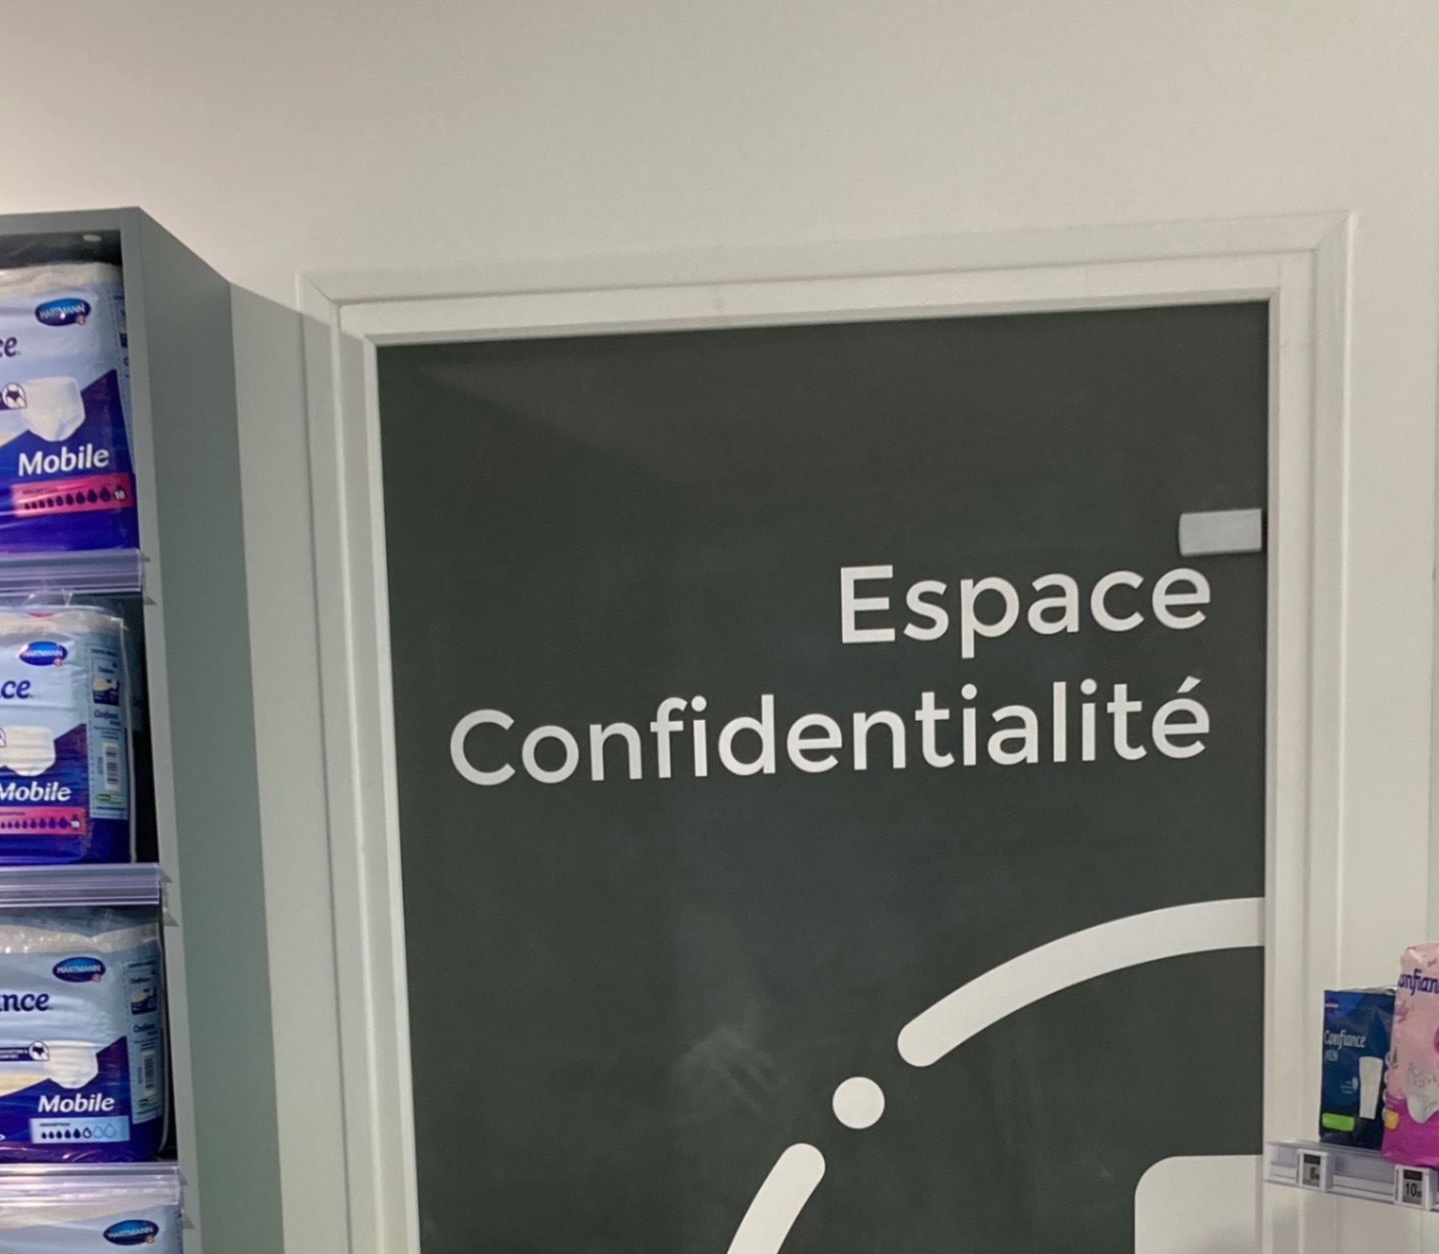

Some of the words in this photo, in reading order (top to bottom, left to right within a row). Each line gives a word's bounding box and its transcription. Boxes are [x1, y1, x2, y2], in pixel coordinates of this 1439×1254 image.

[18, 444, 109, 477] Mobile
[840, 564, 1212, 660] Espace
[449, 674, 1212, 788] Confidentialité
[1323, 1030, 1366, 1049] Confiance
[38, 1093, 115, 1114] Mobile
[1405, 1182, 1417, 1197] 10
